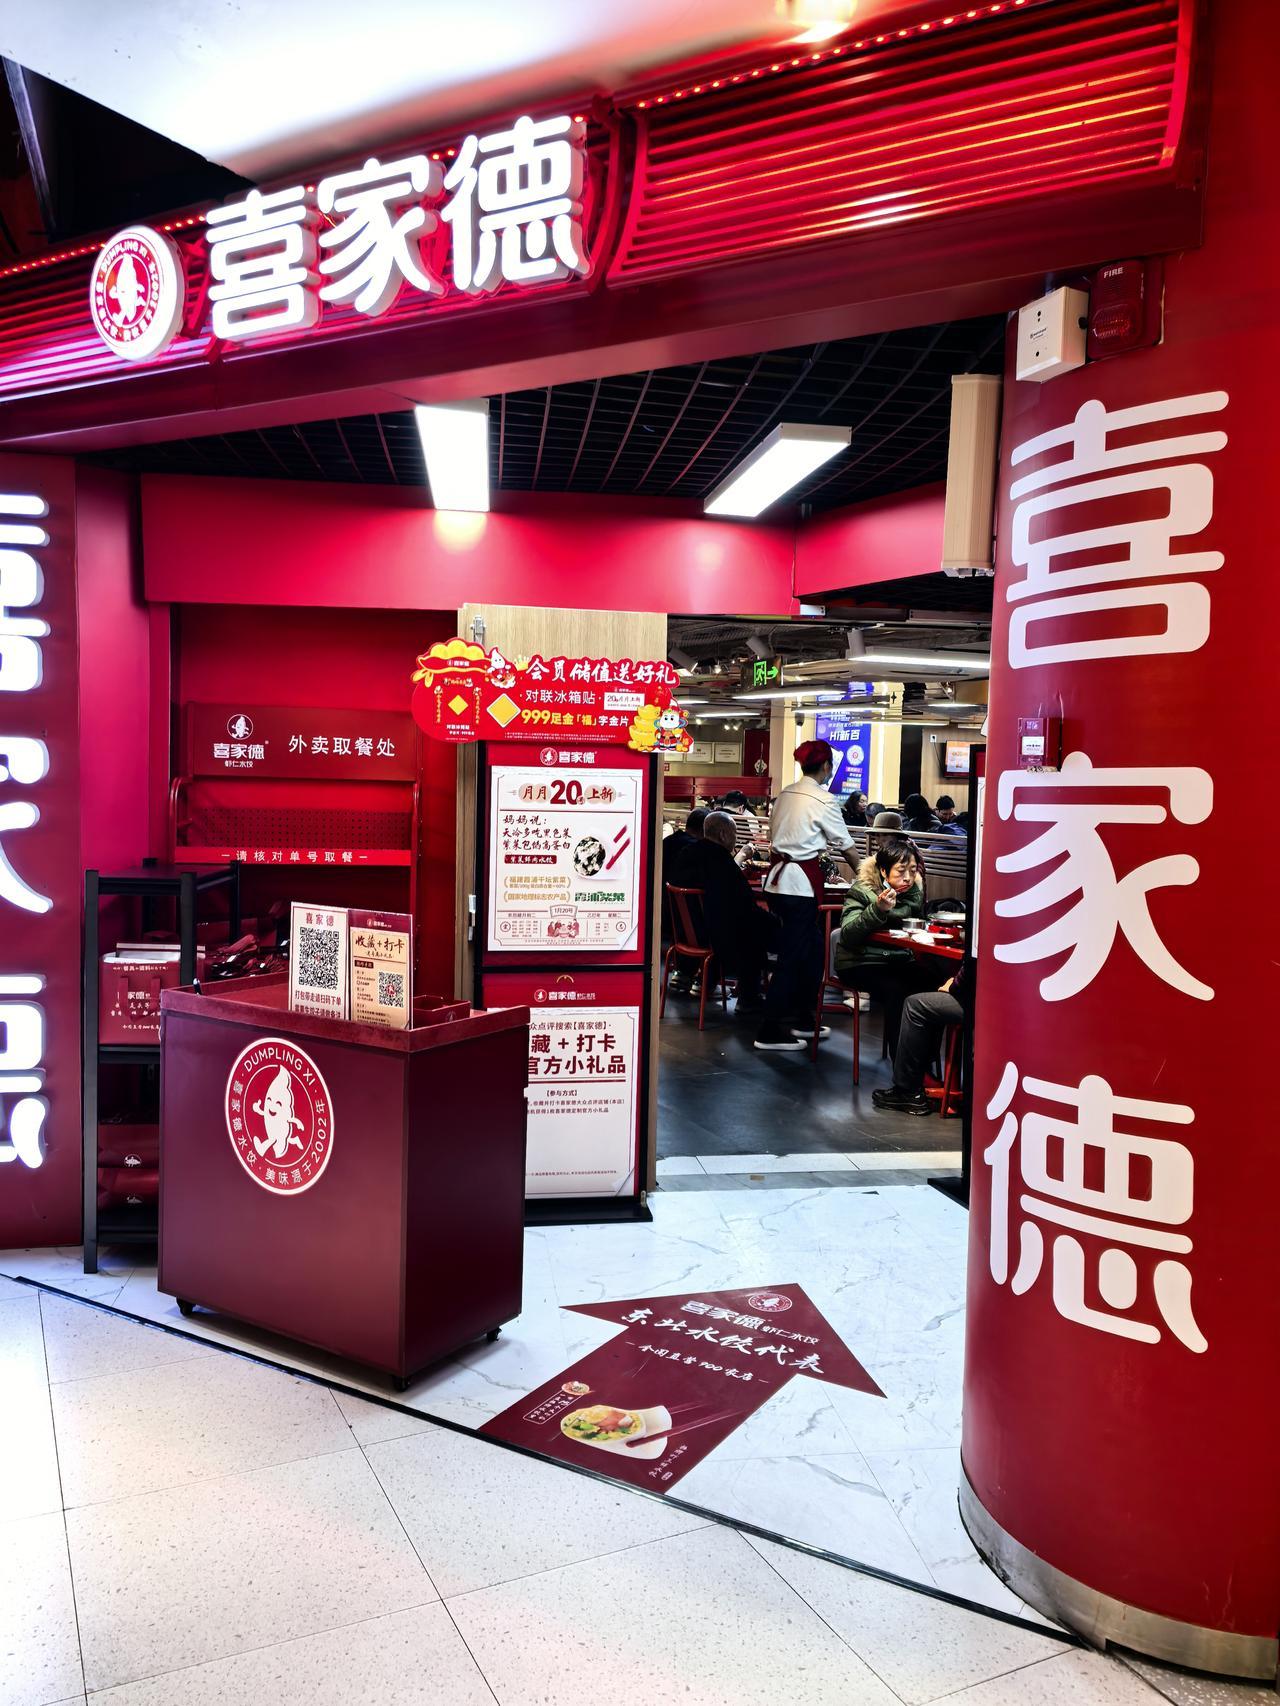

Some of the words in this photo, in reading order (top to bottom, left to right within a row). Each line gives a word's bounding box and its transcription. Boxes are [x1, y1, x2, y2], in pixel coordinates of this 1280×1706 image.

[206, 116, 589, 340] 喜家德
[1103, 267, 1124, 279] FIRE
[525, 657, 677, 685] 会员储值送好礼
[525, 689, 595, 705] 对联冰箱贴
[213, 743, 265, 760] 喜家德
[288, 735, 396, 757] 外卖取餐处
[558, 751, 595, 764] 喜家德
[502, 827, 572, 839] 天冷多吃黑色菜
[236, 850, 353, 863] 请核对单号取餐
[985, 390, 1230, 1354] 喜家德
[305, 912, 335, 926] 喜家德
[548, 991, 577, 1000] 喜家德
[243, 1047, 303, 1071] DUMPLING
[303, 1068, 316, 1086] XI
[680, 1300, 767, 1330] 喜家德
[761, 1325, 821, 1345] 虾仁水饺
[620, 1308, 825, 1374] 东北水饺代表
